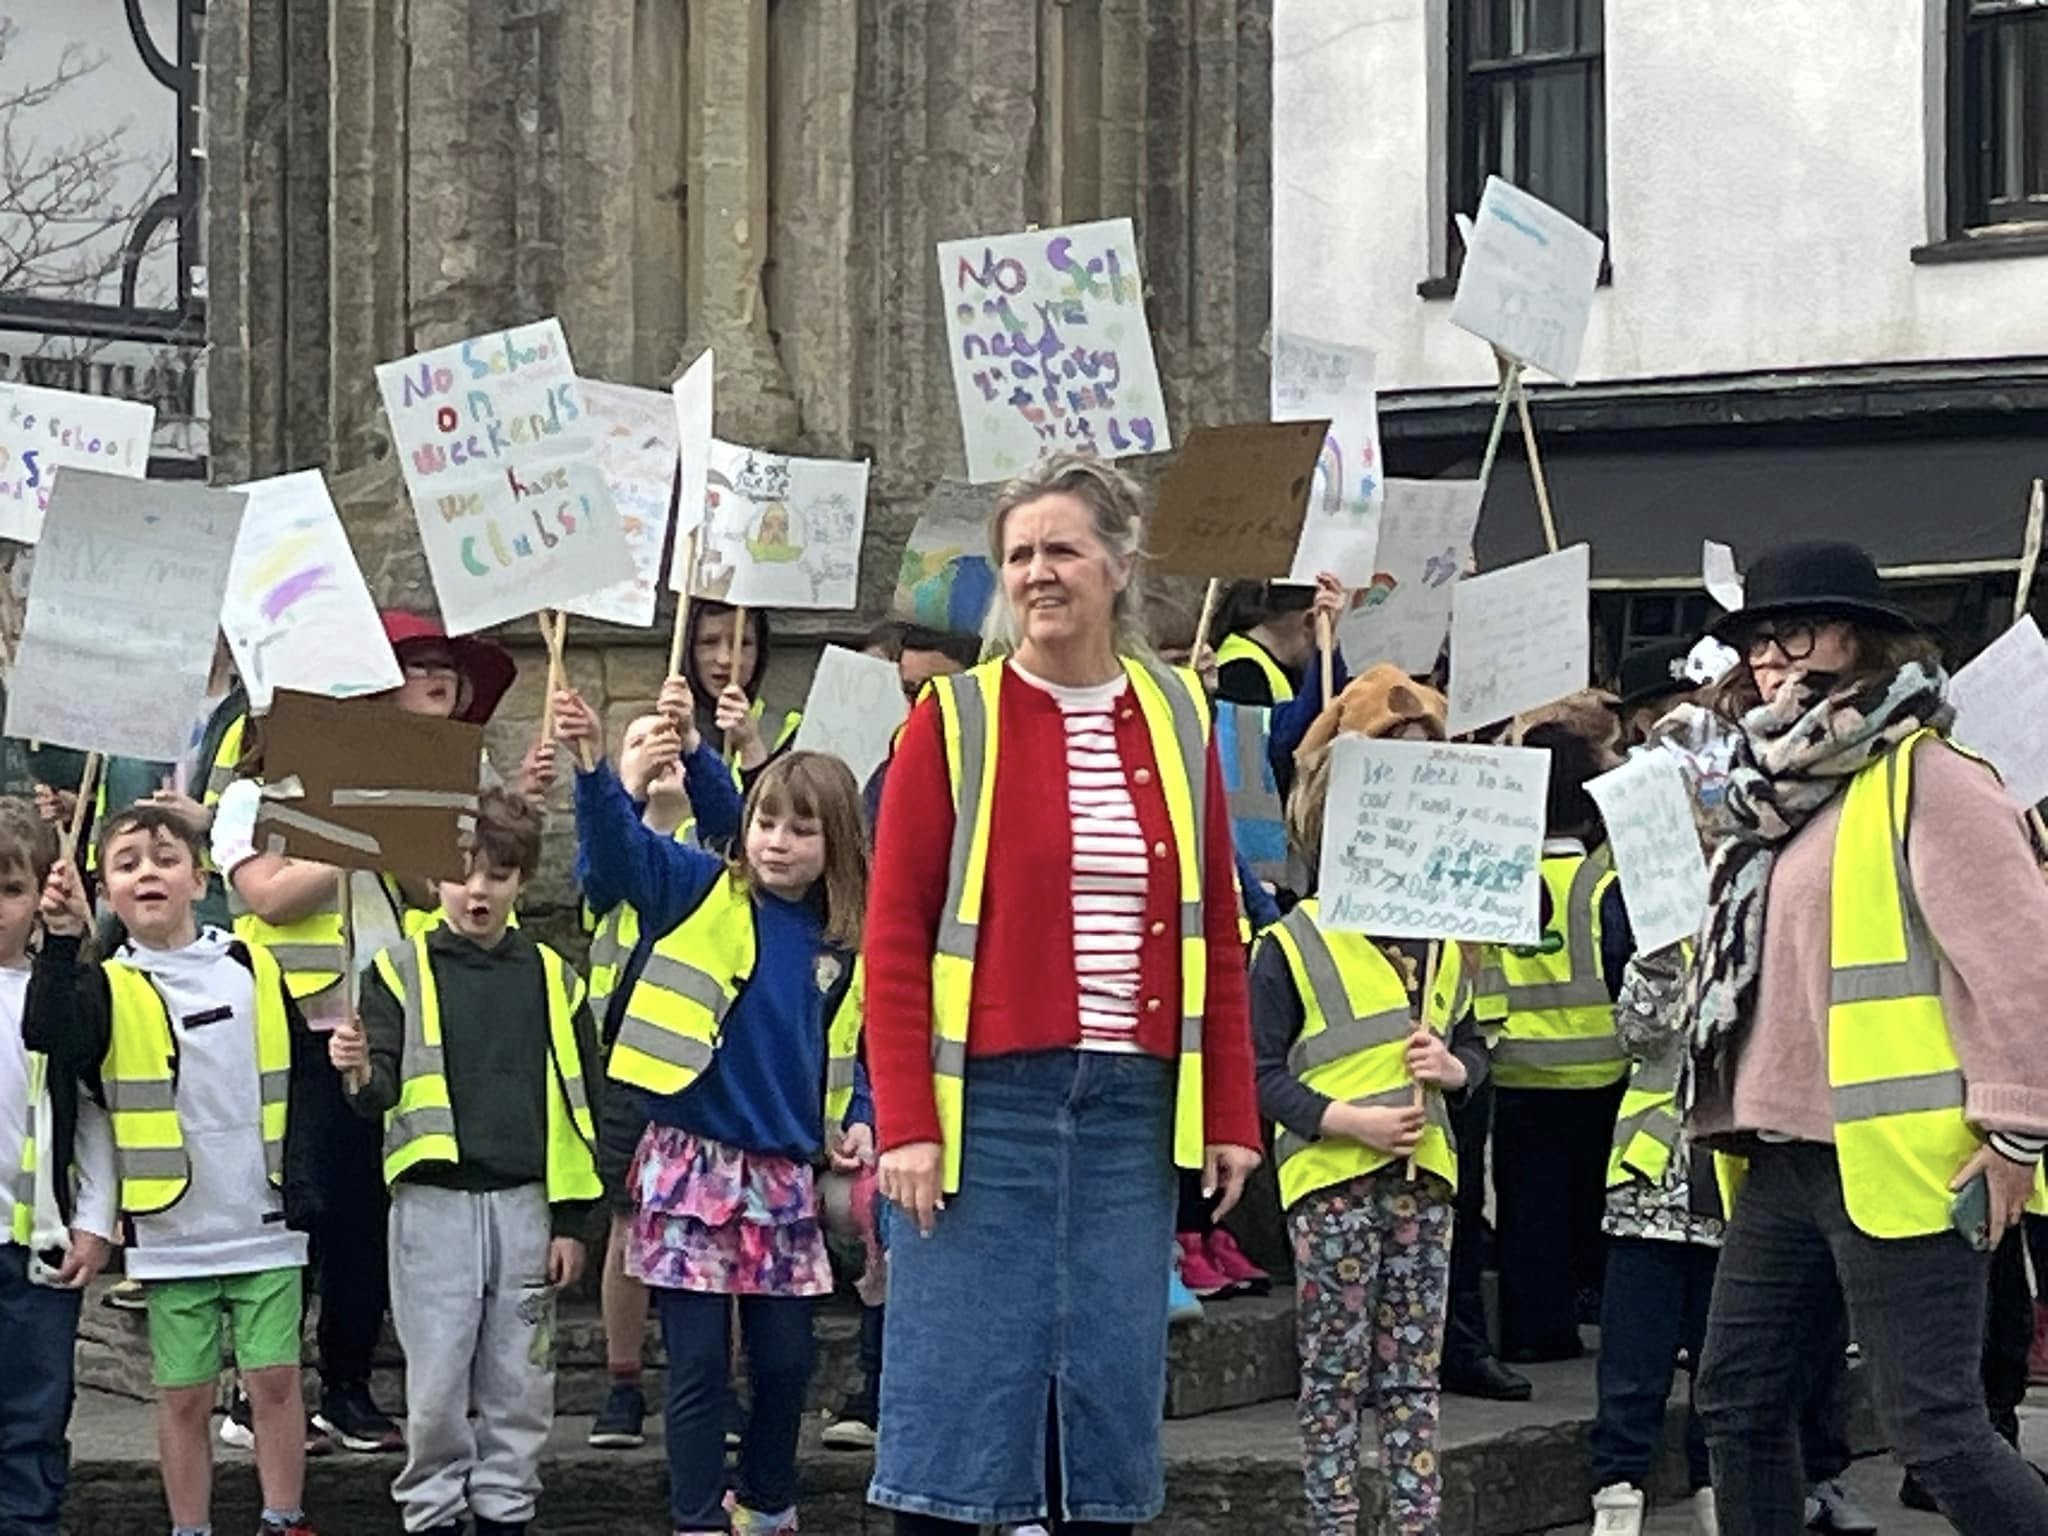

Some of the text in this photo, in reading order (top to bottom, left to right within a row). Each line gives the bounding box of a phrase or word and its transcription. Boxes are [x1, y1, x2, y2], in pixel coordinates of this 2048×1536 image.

[403, 332, 559, 408] No School
[437, 389, 494, 433] on
